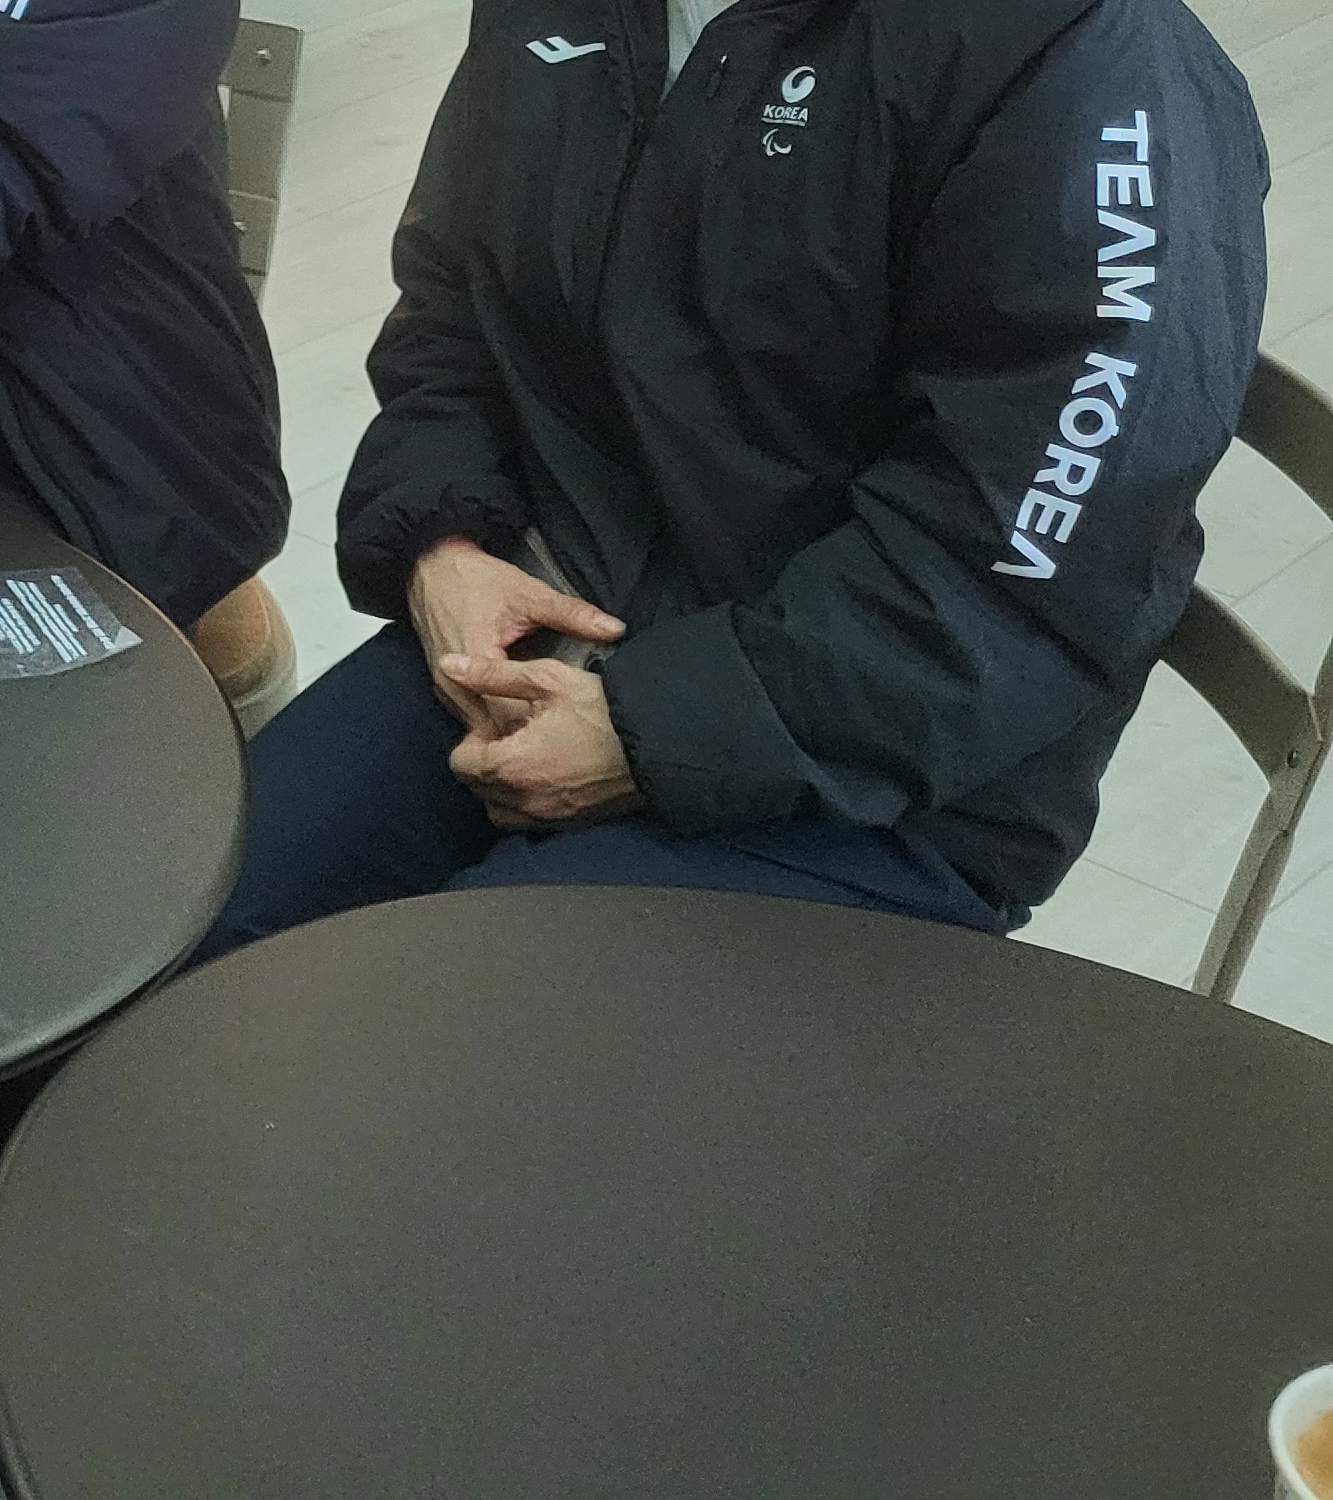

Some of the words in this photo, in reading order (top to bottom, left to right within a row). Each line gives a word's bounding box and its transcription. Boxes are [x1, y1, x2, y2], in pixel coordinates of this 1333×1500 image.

[762, 103, 809, 121] KOREA
[1096, 109, 1157, 323] TEAM
[990, 351, 1138, 580] KOREA
